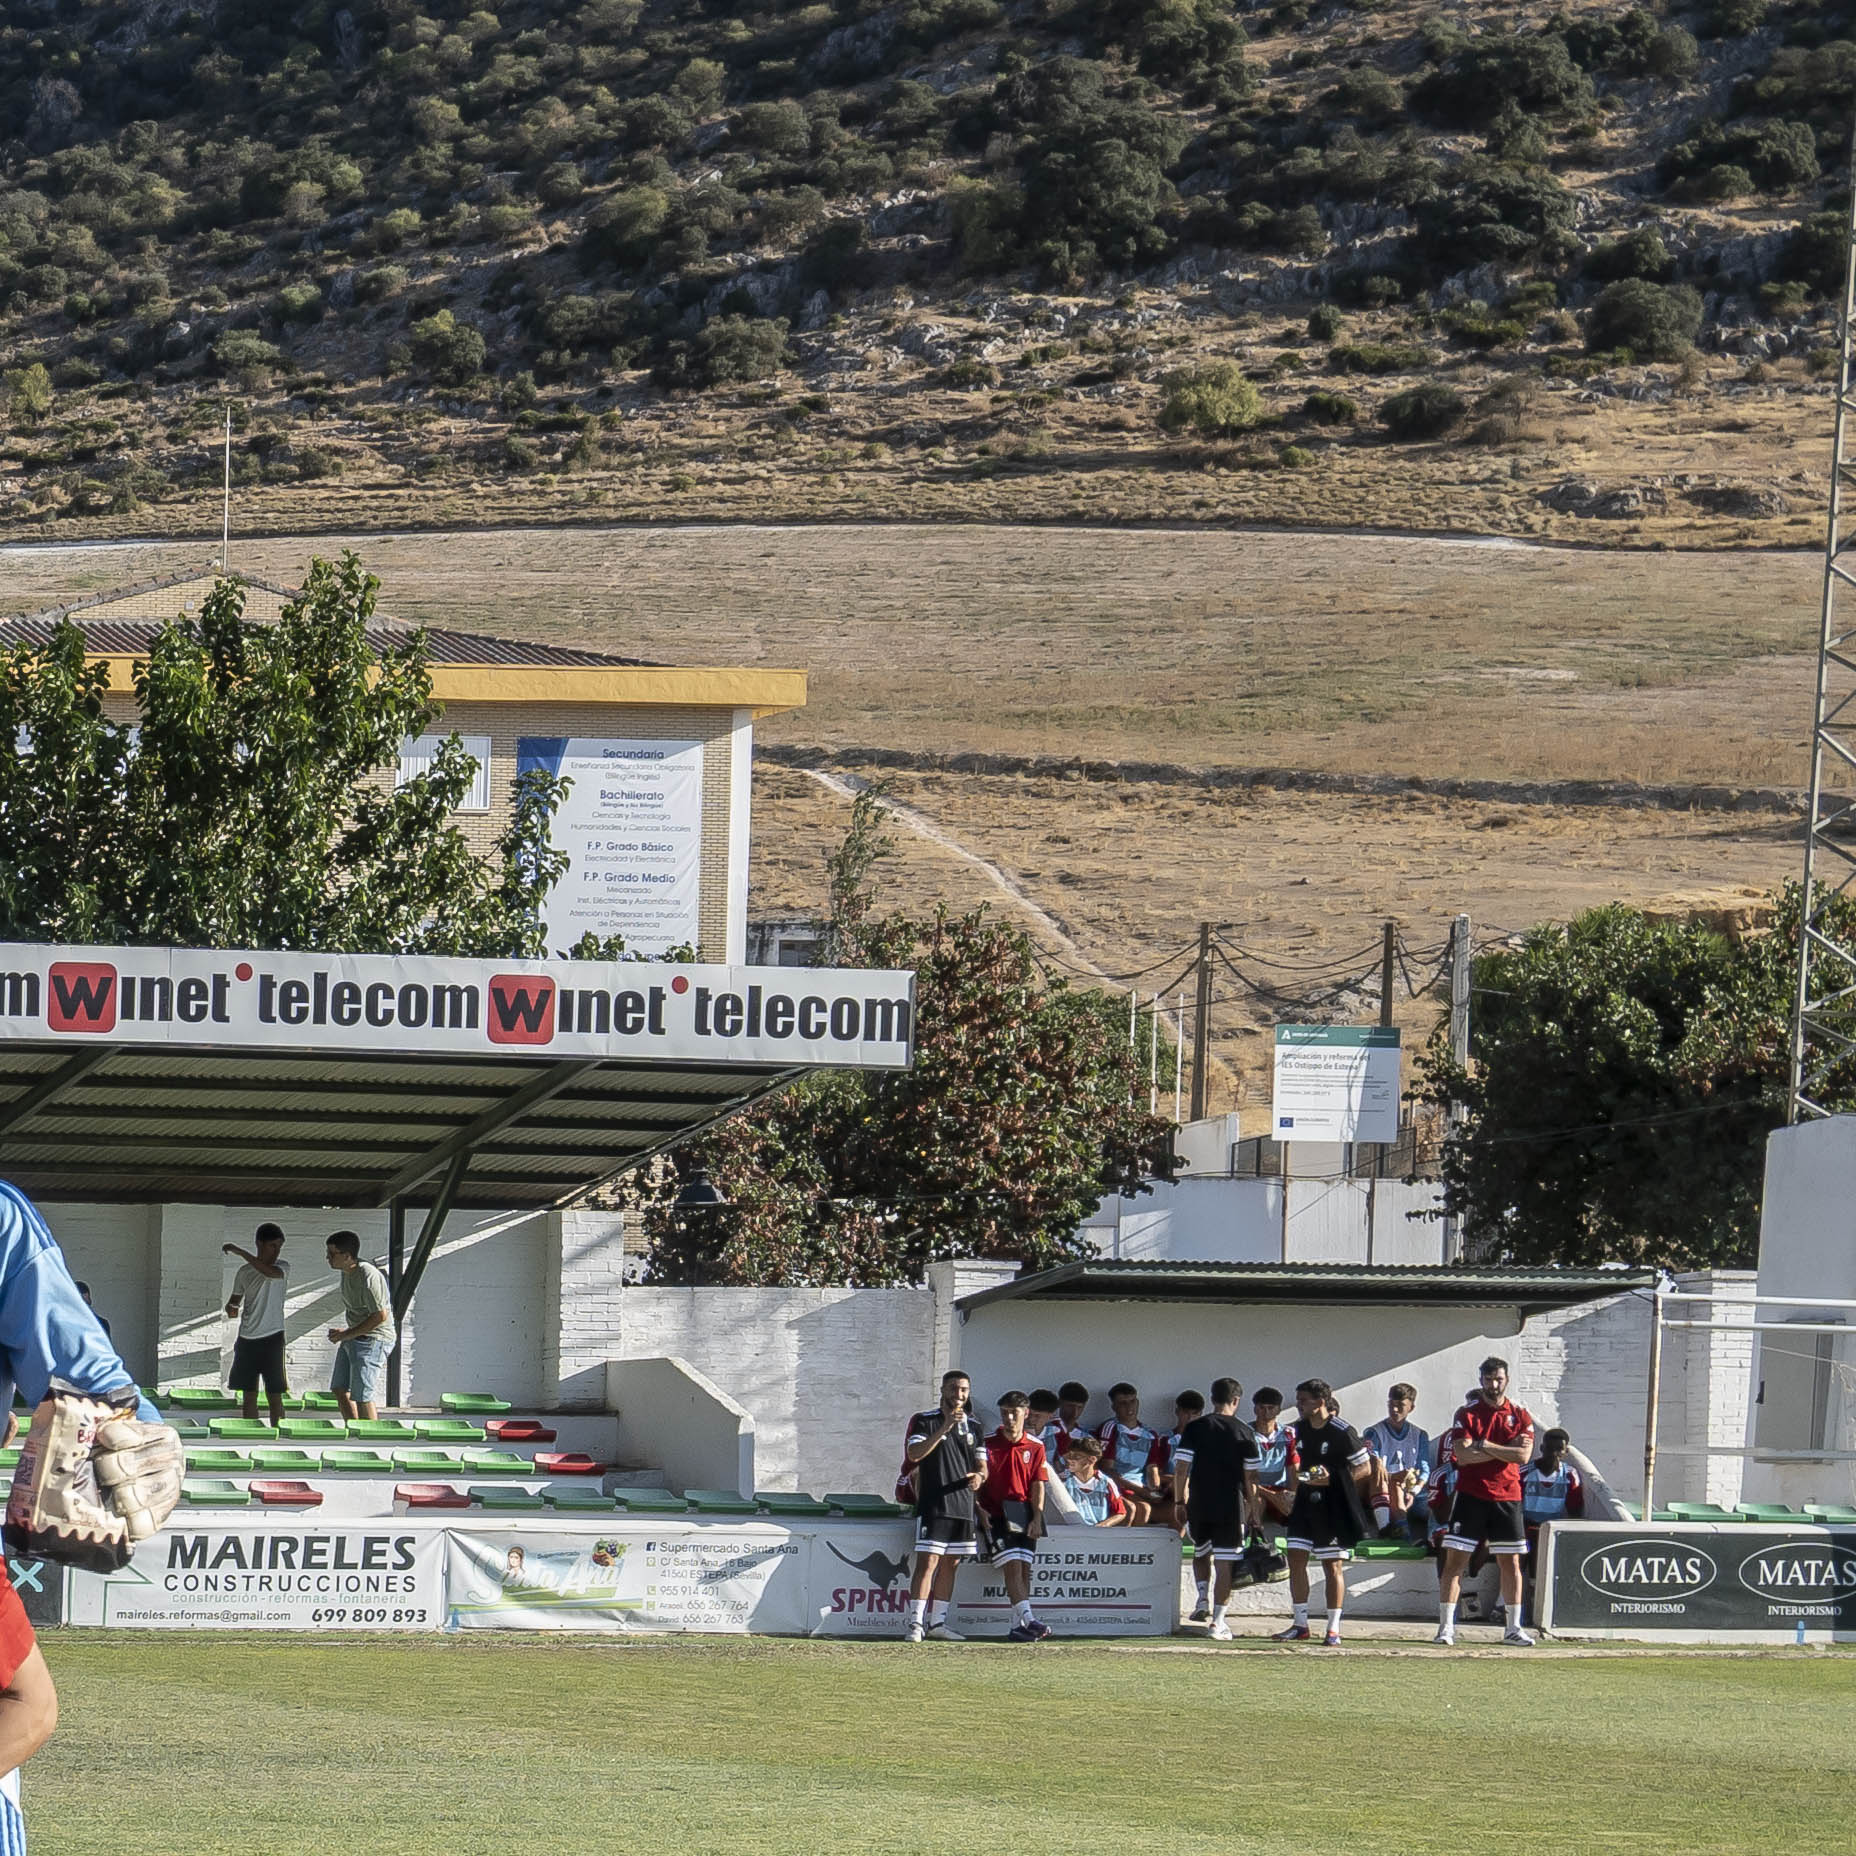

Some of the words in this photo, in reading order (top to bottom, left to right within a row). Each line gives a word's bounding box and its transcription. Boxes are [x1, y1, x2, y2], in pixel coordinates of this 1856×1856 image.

[603, 749, 664, 760] Secundaria
[600, 790, 664, 800] Bachillerato
[587, 841, 603, 851] F.P.
[607, 842, 638, 851] Grado
[641, 842, 673, 852] Básico
[584, 872, 601, 881] F.P.
[604, 872, 638, 882] Grado
[642, 873, 675, 883] Medio
[258, 971, 480, 1029] telecom
[694, 986, 911, 1043] telecom
[167, 1535, 416, 1571] MAIRELES
[660, 1542, 740, 1554] Supermercado
[744, 1543, 776, 1554] Santa
[777, 1544, 799, 1555] Ana
[1065, 1554, 1084, 1565] DE
[1090, 1553, 1154, 1565] MUEBLES
[690, 1570, 728, 1580] ESTEPA
[1038, 1570, 1098, 1582] OFICINA
[1600, 1557, 1702, 1585] MATAS
[164, 1574, 416, 1592] CONSTRUCCIONES
[1054, 1587, 1064, 1598] A
[1069, 1587, 1127, 1598] MEDIDA
[172, 1593, 258, 1604] construcción
[269, 1594, 328, 1604] reformas
[339, 1594, 407, 1605] fontanería
[1610, 1603, 1685, 1615] INTERIORISMO
[1767, 1605, 1843, 1617] INTERIORISMO
[116, 1609, 292, 1623] maireles.reformas@gmail.com
[312, 1608, 346, 1623] 699
[352, 1608, 386, 1623] 809
[392, 1608, 427, 1623] 893
